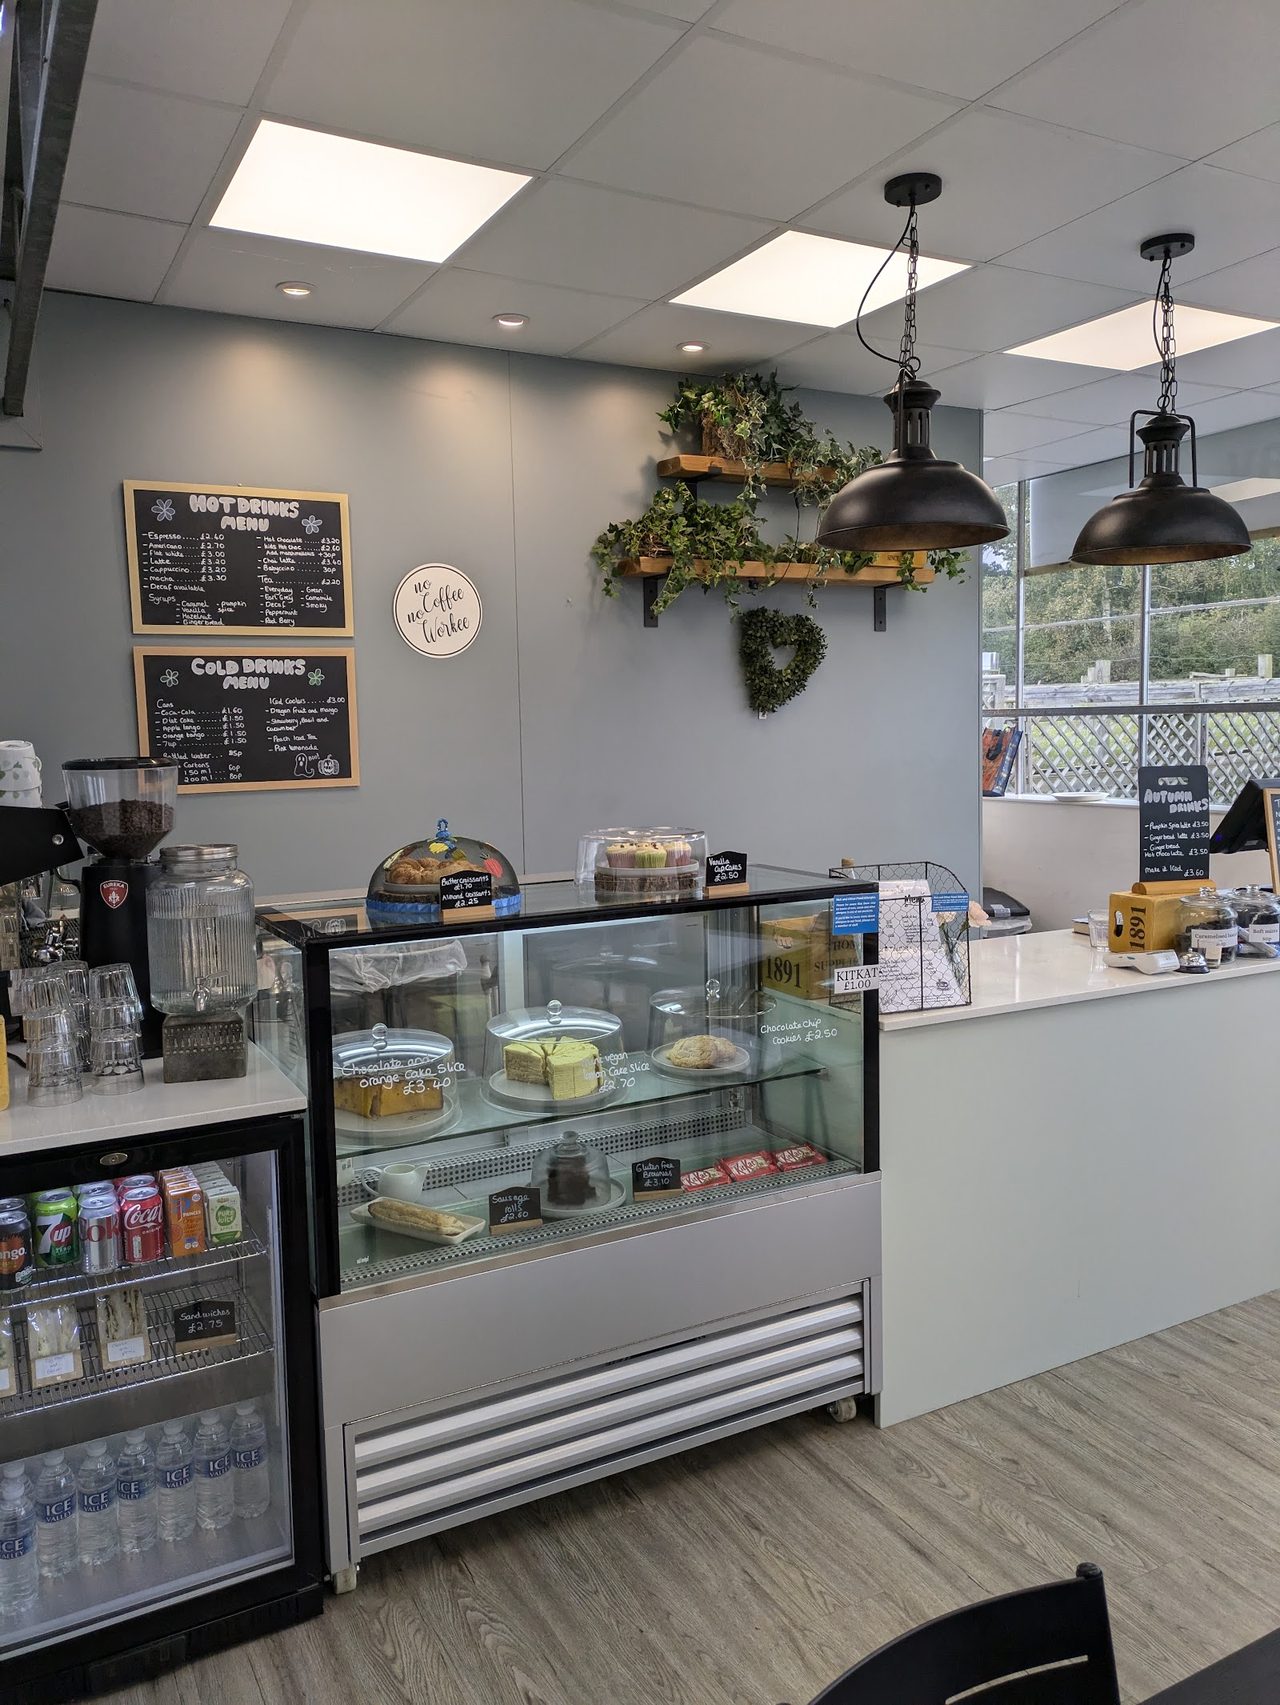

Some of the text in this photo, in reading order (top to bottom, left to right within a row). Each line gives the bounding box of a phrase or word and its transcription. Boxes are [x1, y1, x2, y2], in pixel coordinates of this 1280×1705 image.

[189, 494, 300, 518] HOT DRINKS
[221, 515, 270, 532] MENU
[148, 532, 182, 541] Espresso
[257, 574, 274, 583] Tea
[150, 583, 205, 592] Decaf available
[264, 585, 293, 596] Everyday
[414, 579, 431, 594] no
[148, 593, 176, 605] Syrups
[420, 584, 464, 613] Coffee
[407, 609, 425, 623] no
[417, 613, 469, 643] Workee
[191, 657, 306, 676] COLD DRINKS
[223, 676, 270, 690] MENU
[1143, 788, 1193, 804] AUTUMN
[1169, 798, 1209, 814] DRINKS
[1189, 848, 1208, 856] £3.50
[714, 871, 739, 882] £2.50
[1183, 869, 1204, 877] £3.60
[454, 883, 473, 891] £1.70
[442, 892, 464, 901] Almond
[454, 898, 479, 908] £2.25
[1130, 906, 1147, 950] 1891
[766, 956, 802, 989] 1891
[844, 979, 871, 991] £1.00
[760, 1021, 802, 1034] Chocolate
[805, 1028, 837, 1042] £2.50
[604, 1052, 628, 1065] vegan
[341, 1055, 434, 1076] Chocolate and
[359, 1073, 399, 1089] orange
[403, 1077, 451, 1095] £3.40
[599, 1077, 636, 1093] £2.70
[635, 1163, 660, 1173] Gluten
[644, 1177, 670, 1187] £3.10
[492, 1194, 530, 1204] Sausage
[500, 1211, 529, 1223] £2.60
[179, 1308, 231, 1321] Sandwiches
[187, 1320, 224, 1334] £2.75
[236, 1447, 260, 1463] ICE
[208, 1455, 231, 1471] ICE
[236, 1458, 260, 1470] VALLEY
[166, 1467, 190, 1482] ICE
[209, 1466, 231, 1478] VALLEY
[118, 1481, 139, 1494] ICE
[166, 1476, 190, 1488] VALLEY
[83, 1491, 109, 1506] ICE
[46, 1500, 72, 1516] ICE
[83, 1501, 110, 1513] VALLEY
[46, 1511, 73, 1523] VALLEY
